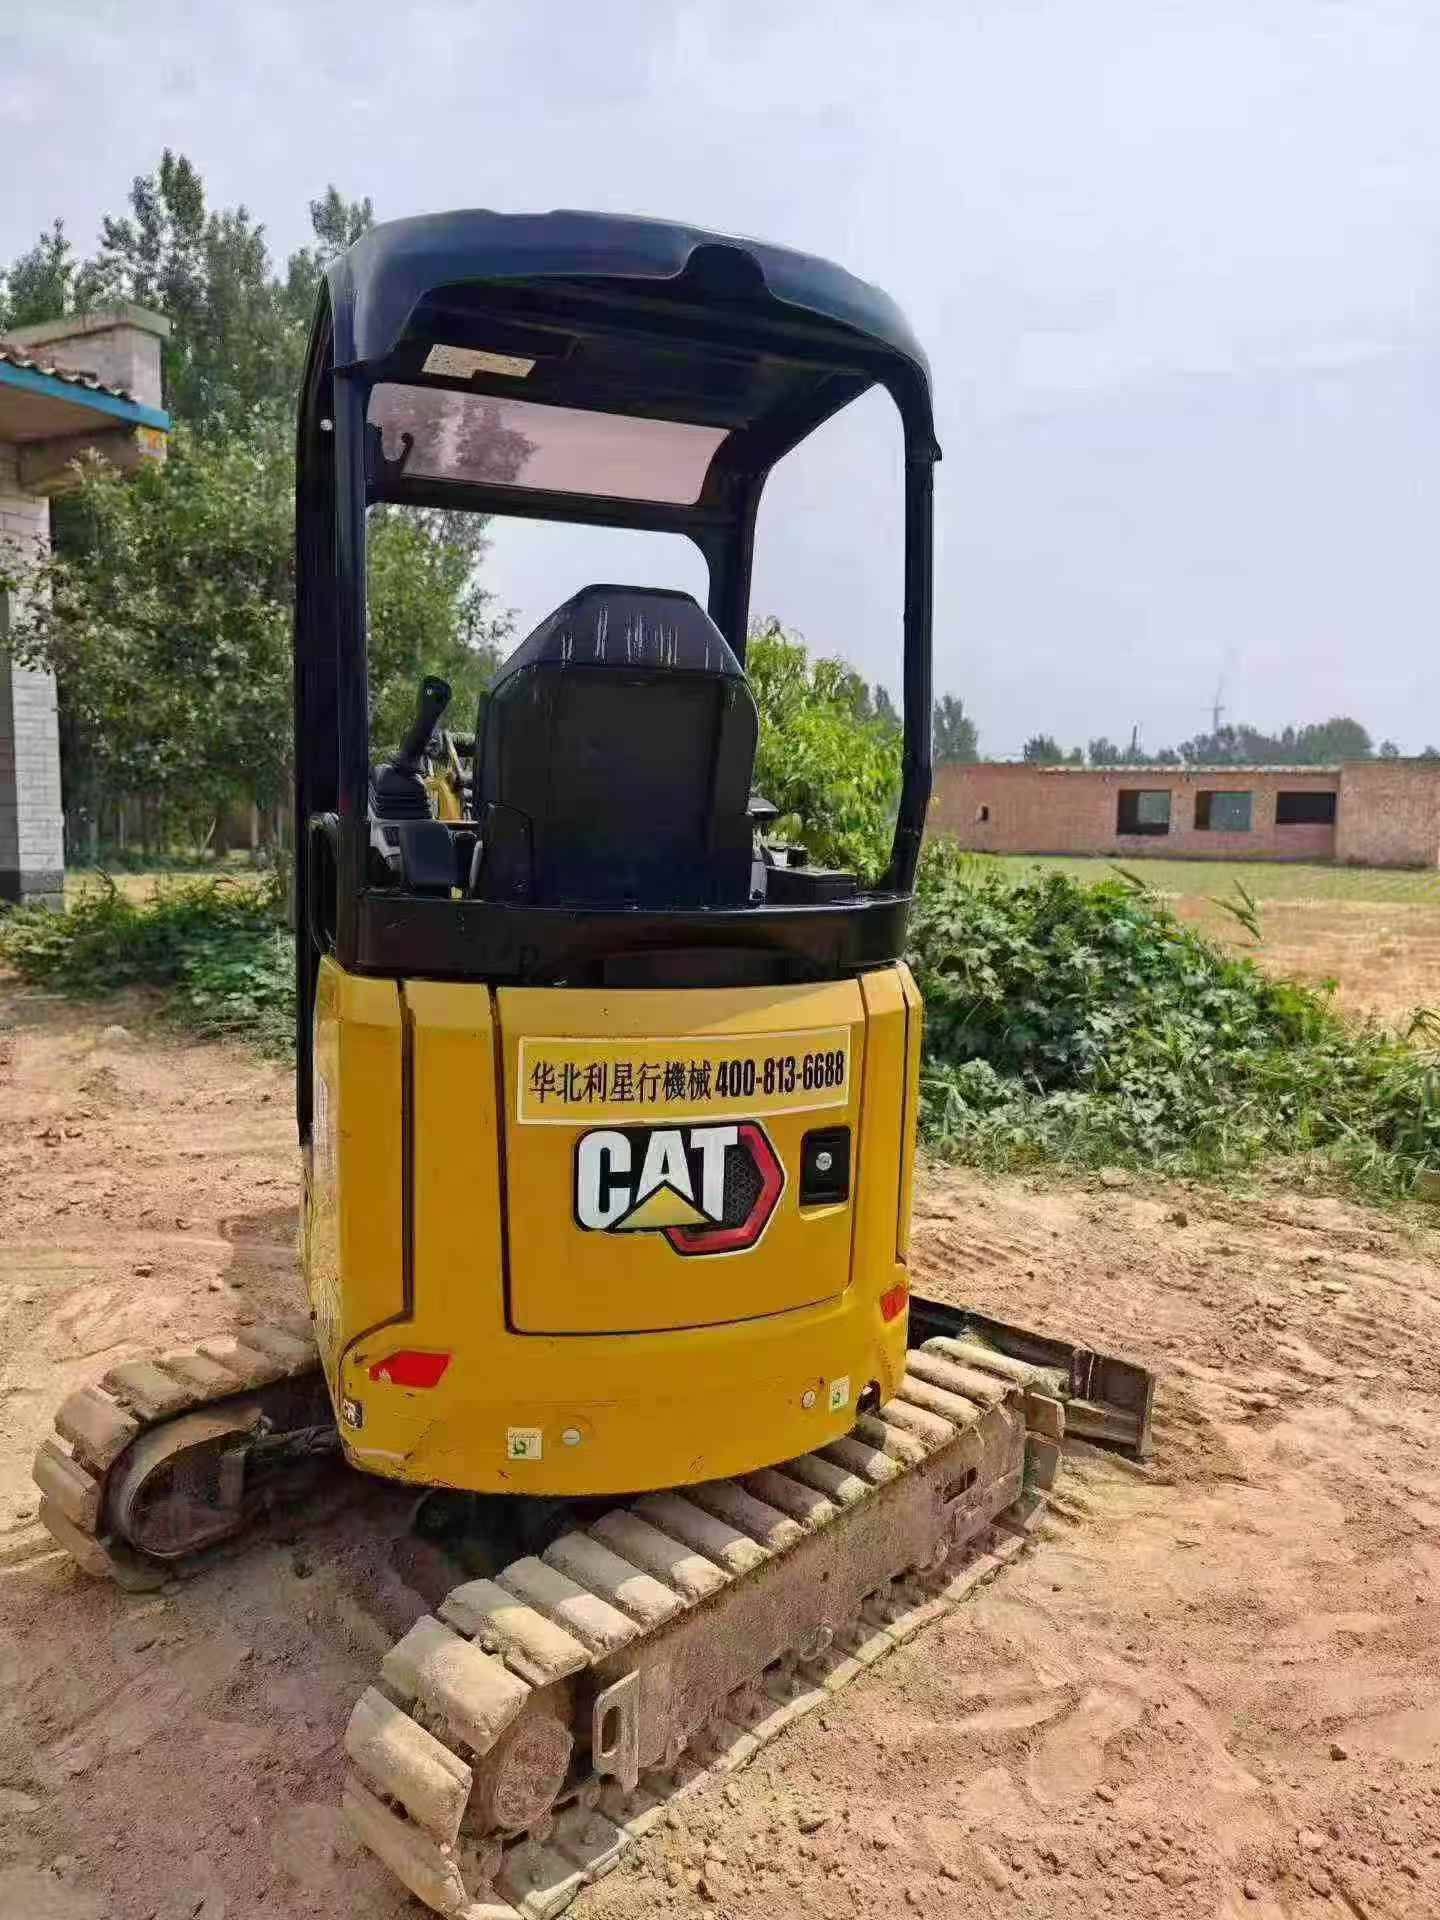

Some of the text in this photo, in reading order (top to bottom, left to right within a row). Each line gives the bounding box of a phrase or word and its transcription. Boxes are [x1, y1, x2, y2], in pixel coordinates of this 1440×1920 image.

[529, 1050, 844, 1104] 华北利星行機械 400-813-6688
[577, 1125, 739, 1230] CAT
